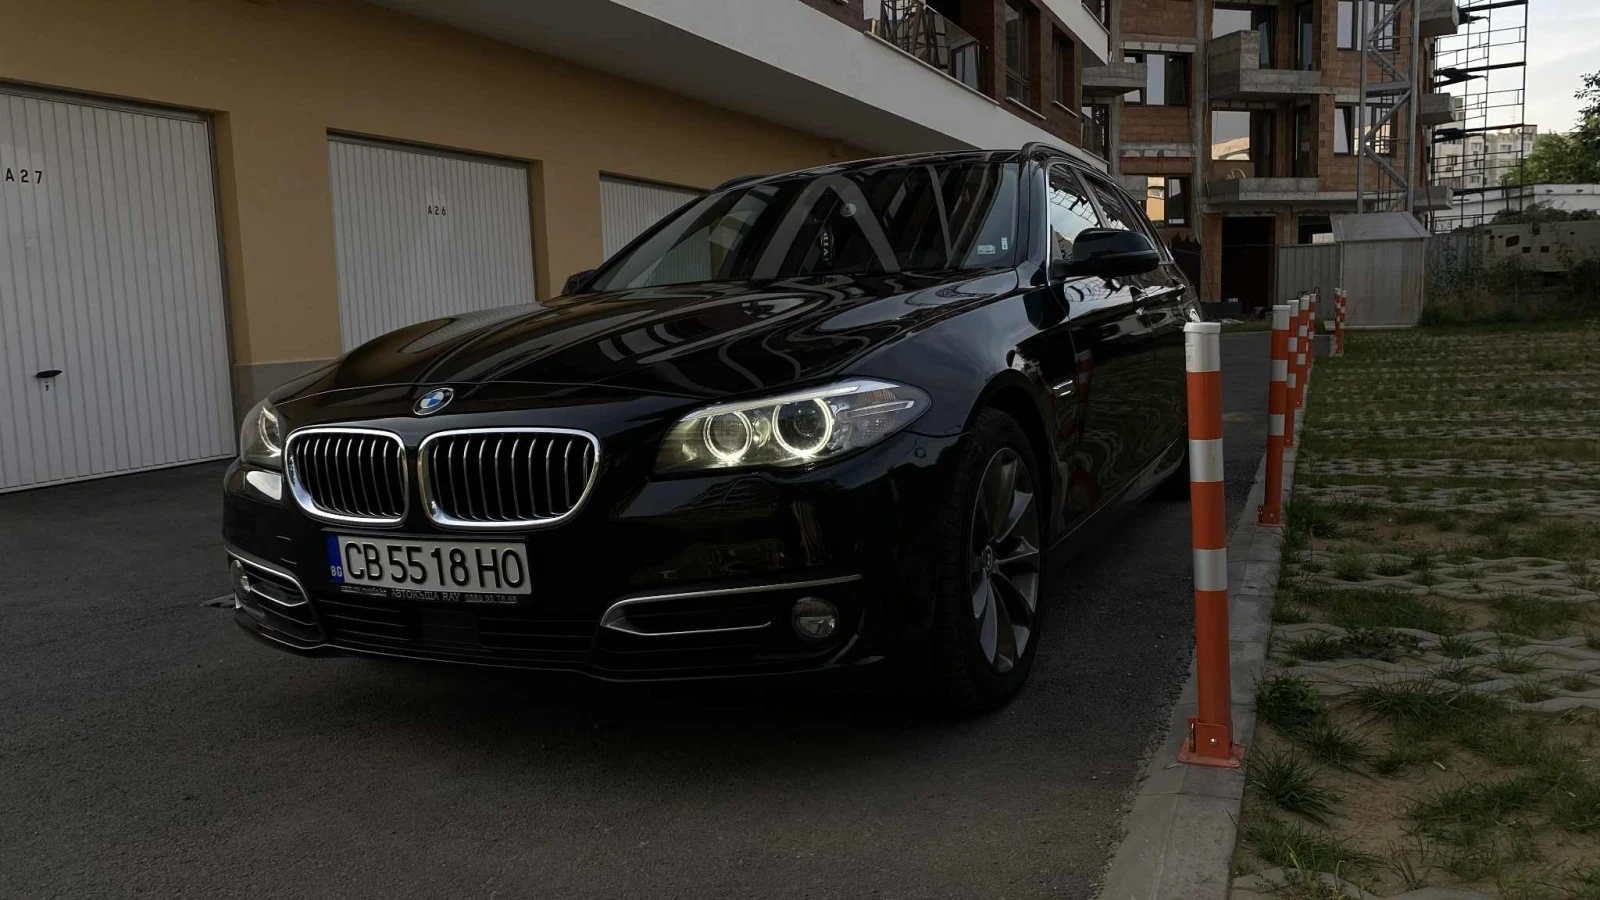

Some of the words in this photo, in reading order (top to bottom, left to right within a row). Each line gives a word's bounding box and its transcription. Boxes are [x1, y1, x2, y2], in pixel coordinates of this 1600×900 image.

[5, 167, 43, 184] A27
[427, 204, 447, 216] A26
[330, 565, 343, 577] BG
[442, 592, 461, 602] RAY
